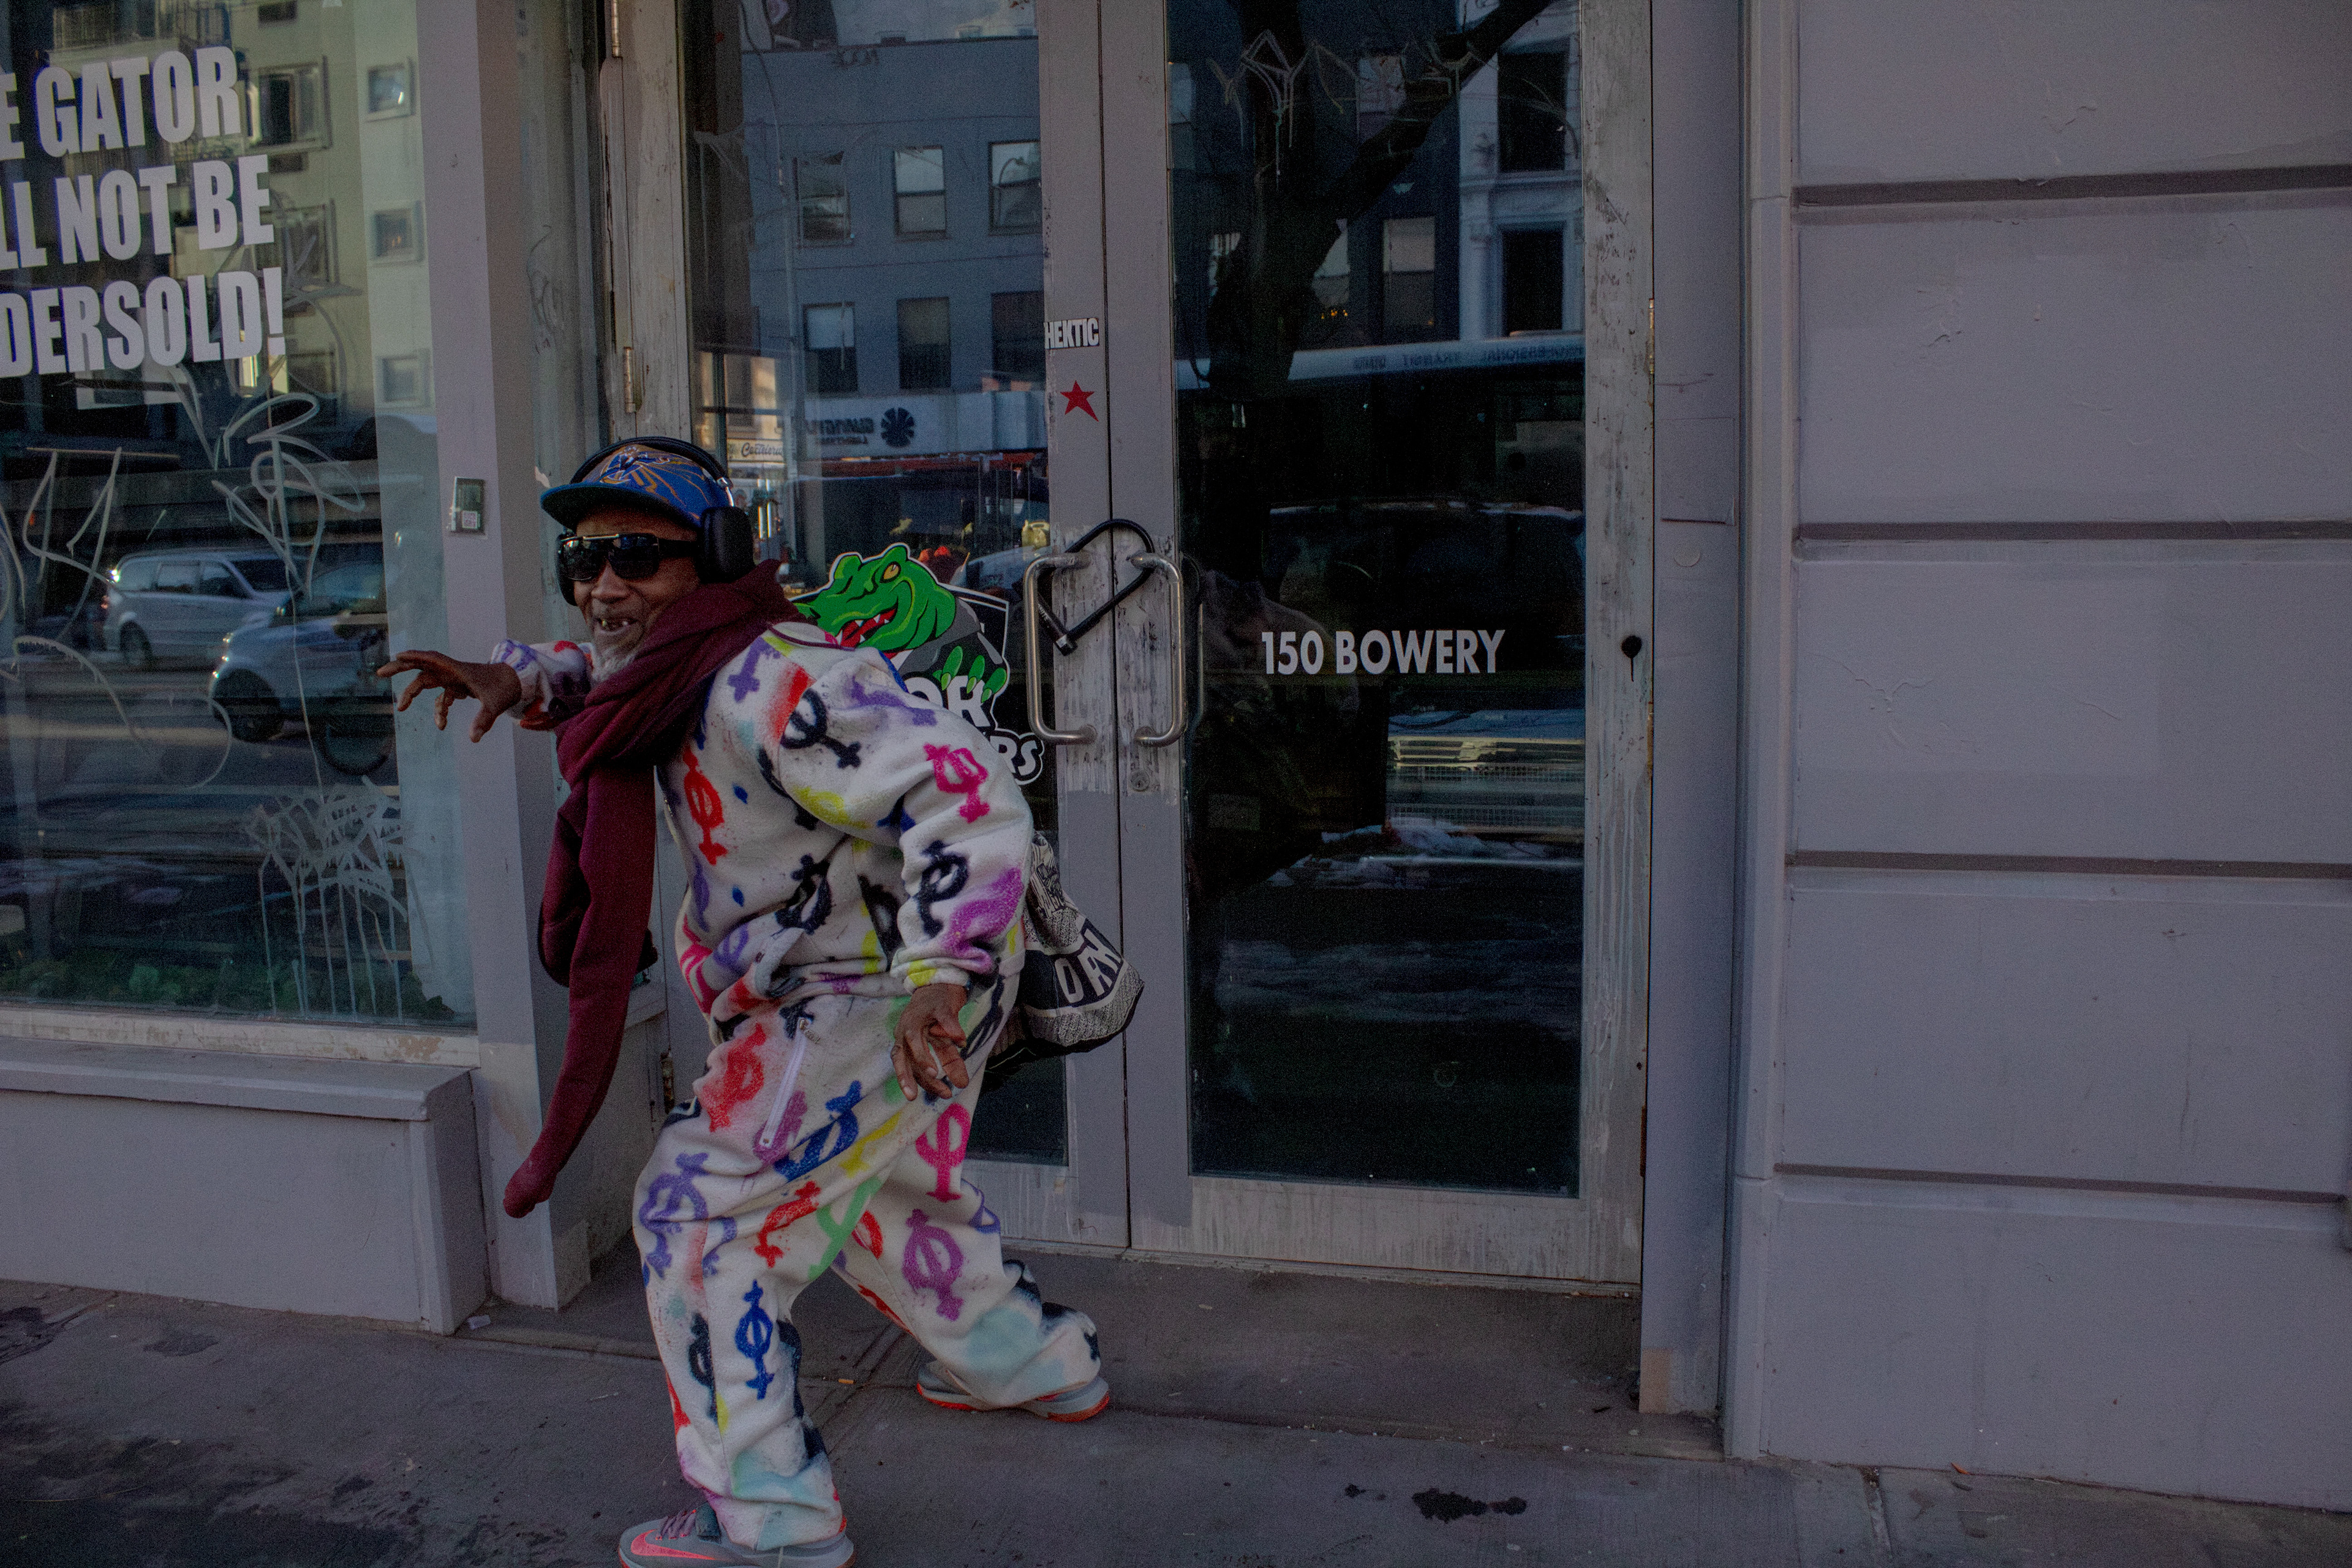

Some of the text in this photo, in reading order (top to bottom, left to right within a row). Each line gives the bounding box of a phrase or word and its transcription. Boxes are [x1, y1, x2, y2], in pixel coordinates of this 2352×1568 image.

[35, 47, 241, 157] GATOR
[55, 165, 176, 264] NOT
[193, 154, 274, 250] BE
[0, 268, 285, 379] DERSOLD!
[1043, 318, 1099, 349] HEKTIC
[1262, 629, 1506, 674] 150 BOWERY
